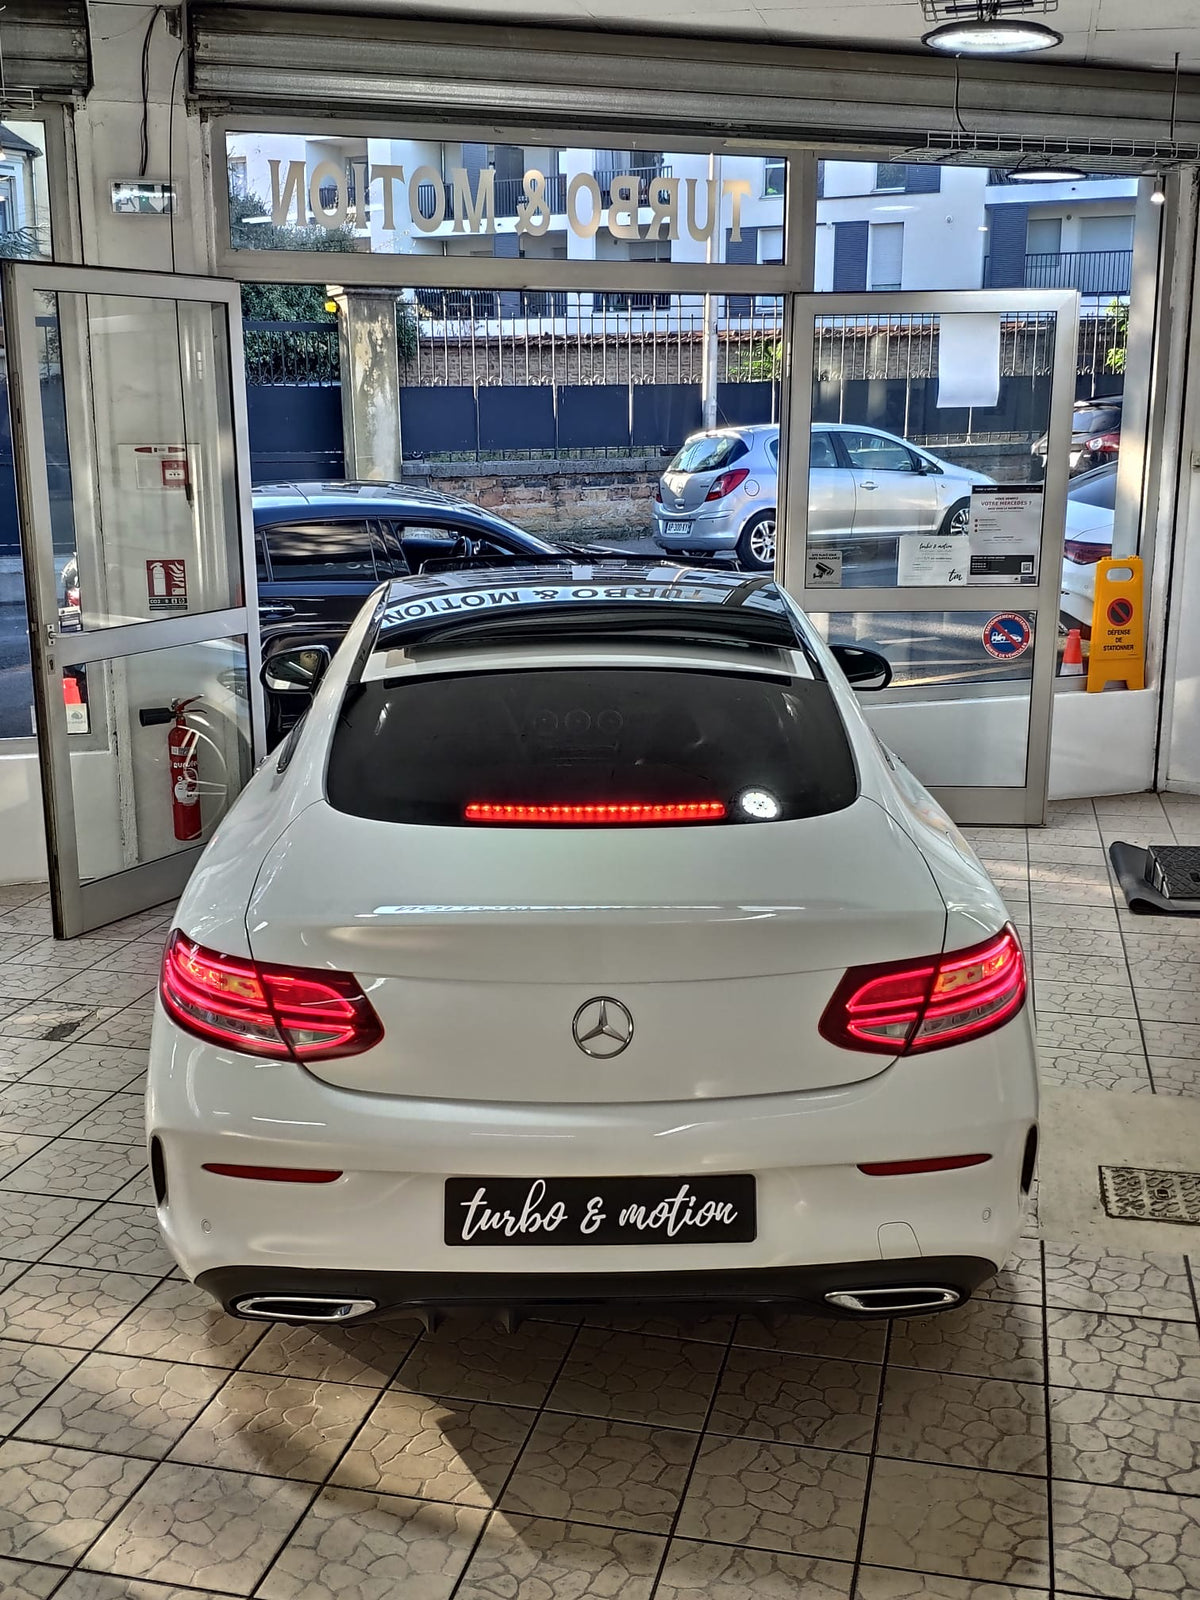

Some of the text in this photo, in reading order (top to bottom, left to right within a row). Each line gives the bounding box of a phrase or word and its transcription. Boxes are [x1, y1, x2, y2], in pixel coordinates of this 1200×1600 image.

[460, 1179, 739, 1241] turbo & motion
